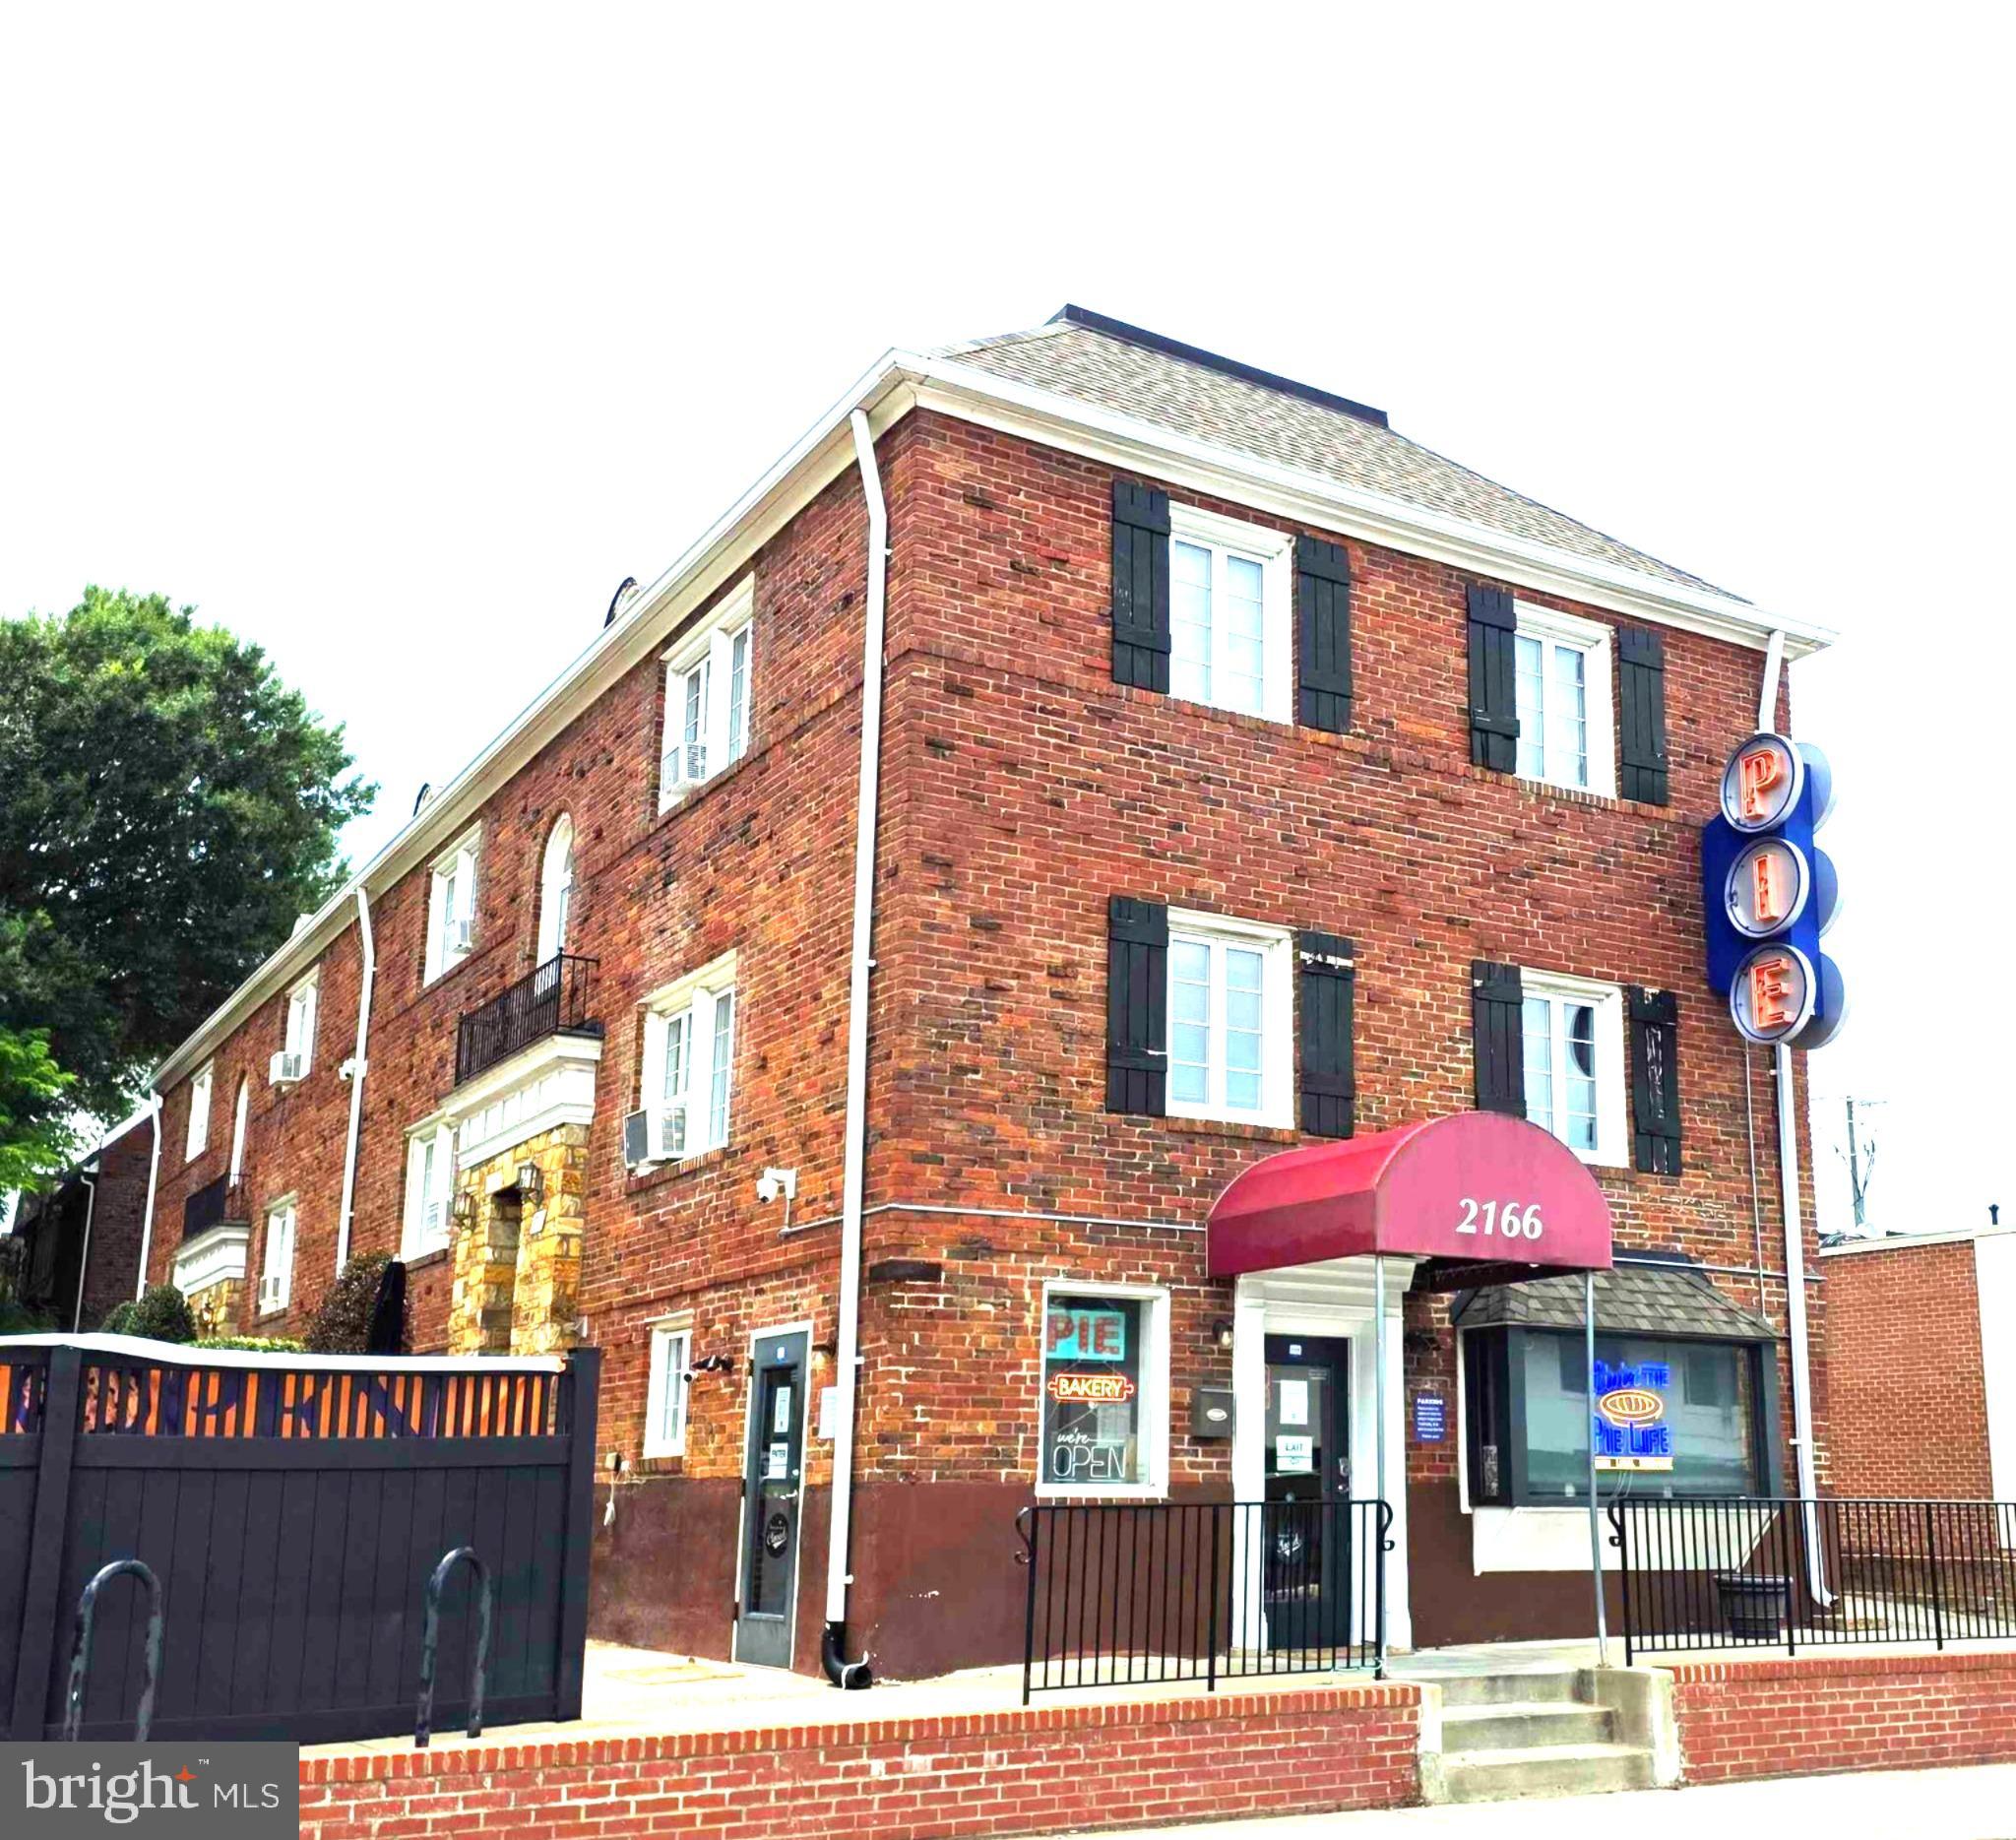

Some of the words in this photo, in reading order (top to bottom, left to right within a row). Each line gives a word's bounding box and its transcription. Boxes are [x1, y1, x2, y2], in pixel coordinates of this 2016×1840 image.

[1739, 748, 1795, 1029] PIE
[1455, 1198, 1544, 1239] 2166
[1046, 1312, 1120, 1355] PIE
[1058, 1377, 1123, 1397] BAKERY
[1593, 1413, 1622, 1453] PIE
[1628, 1422, 1670, 1454] LIFE
[1053, 1445, 1127, 1479] OPEN
